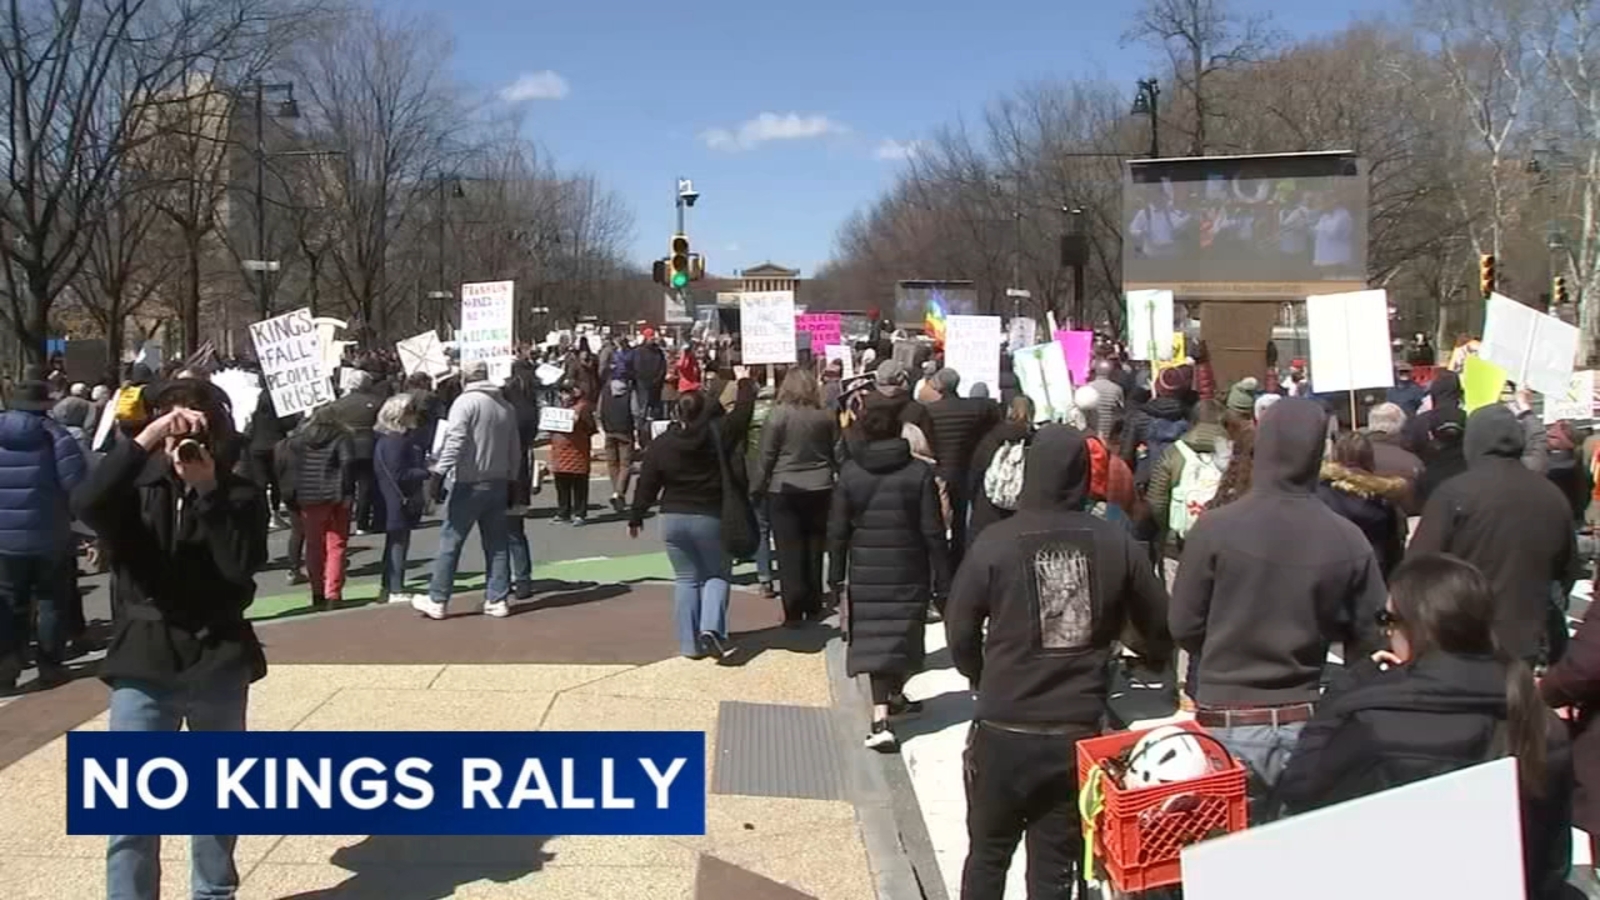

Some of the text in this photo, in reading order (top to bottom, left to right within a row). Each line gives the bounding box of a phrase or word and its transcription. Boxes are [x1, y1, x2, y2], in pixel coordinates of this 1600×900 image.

[251, 309, 312, 347] KINGS
[265, 340, 312, 368] FALL
[266, 363, 321, 391] PEOPLE
[281, 376, 331, 411] RISE!
